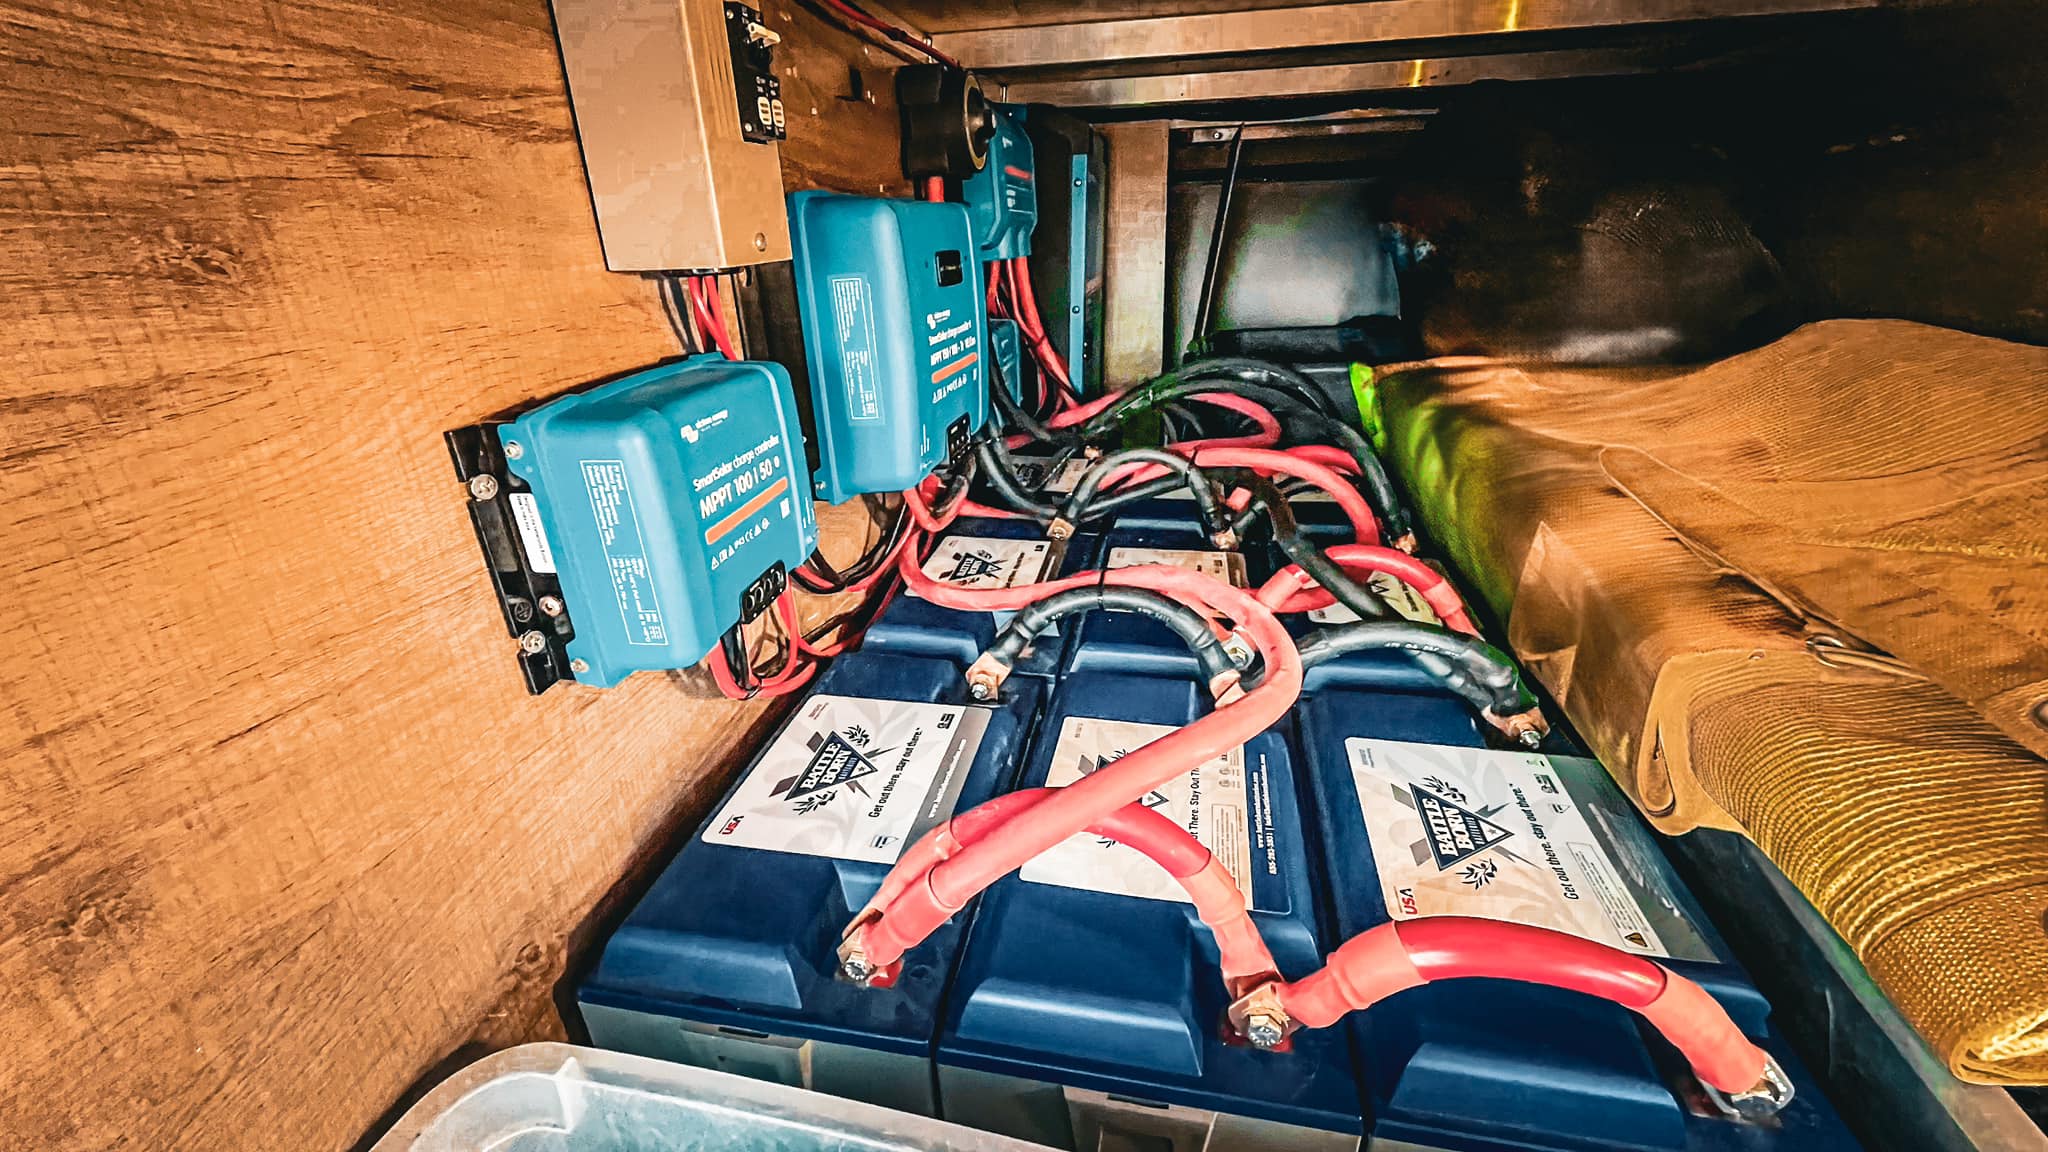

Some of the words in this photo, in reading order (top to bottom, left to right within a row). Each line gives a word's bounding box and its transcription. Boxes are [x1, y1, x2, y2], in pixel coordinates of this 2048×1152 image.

[692, 462, 734, 492] SmartSolar
[733, 450, 754, 470] charge
[699, 483, 733, 519] MPPT
[733, 471, 752, 496] 100
[760, 459, 772, 480] 50
[800, 743, 841, 789] BATTLE
[820, 750, 852, 784] BORN
[868, 805, 884, 818] Get
[879, 792, 890, 805] out
[903, 747, 914, 757] out
[1190, 777, 1200, 789] Out
[1189, 790, 1202, 805] Stay
[721, 815, 745, 835] USA
[1422, 798, 1459, 856] BATTLE
[1442, 806, 1475, 850] BORN
[1521, 809, 1536, 822] out
[1530, 822, 1545, 840] stay
[1552, 866, 1569, 882] out
[1400, 888, 1418, 915] USA
[1560, 883, 1579, 900] Get
